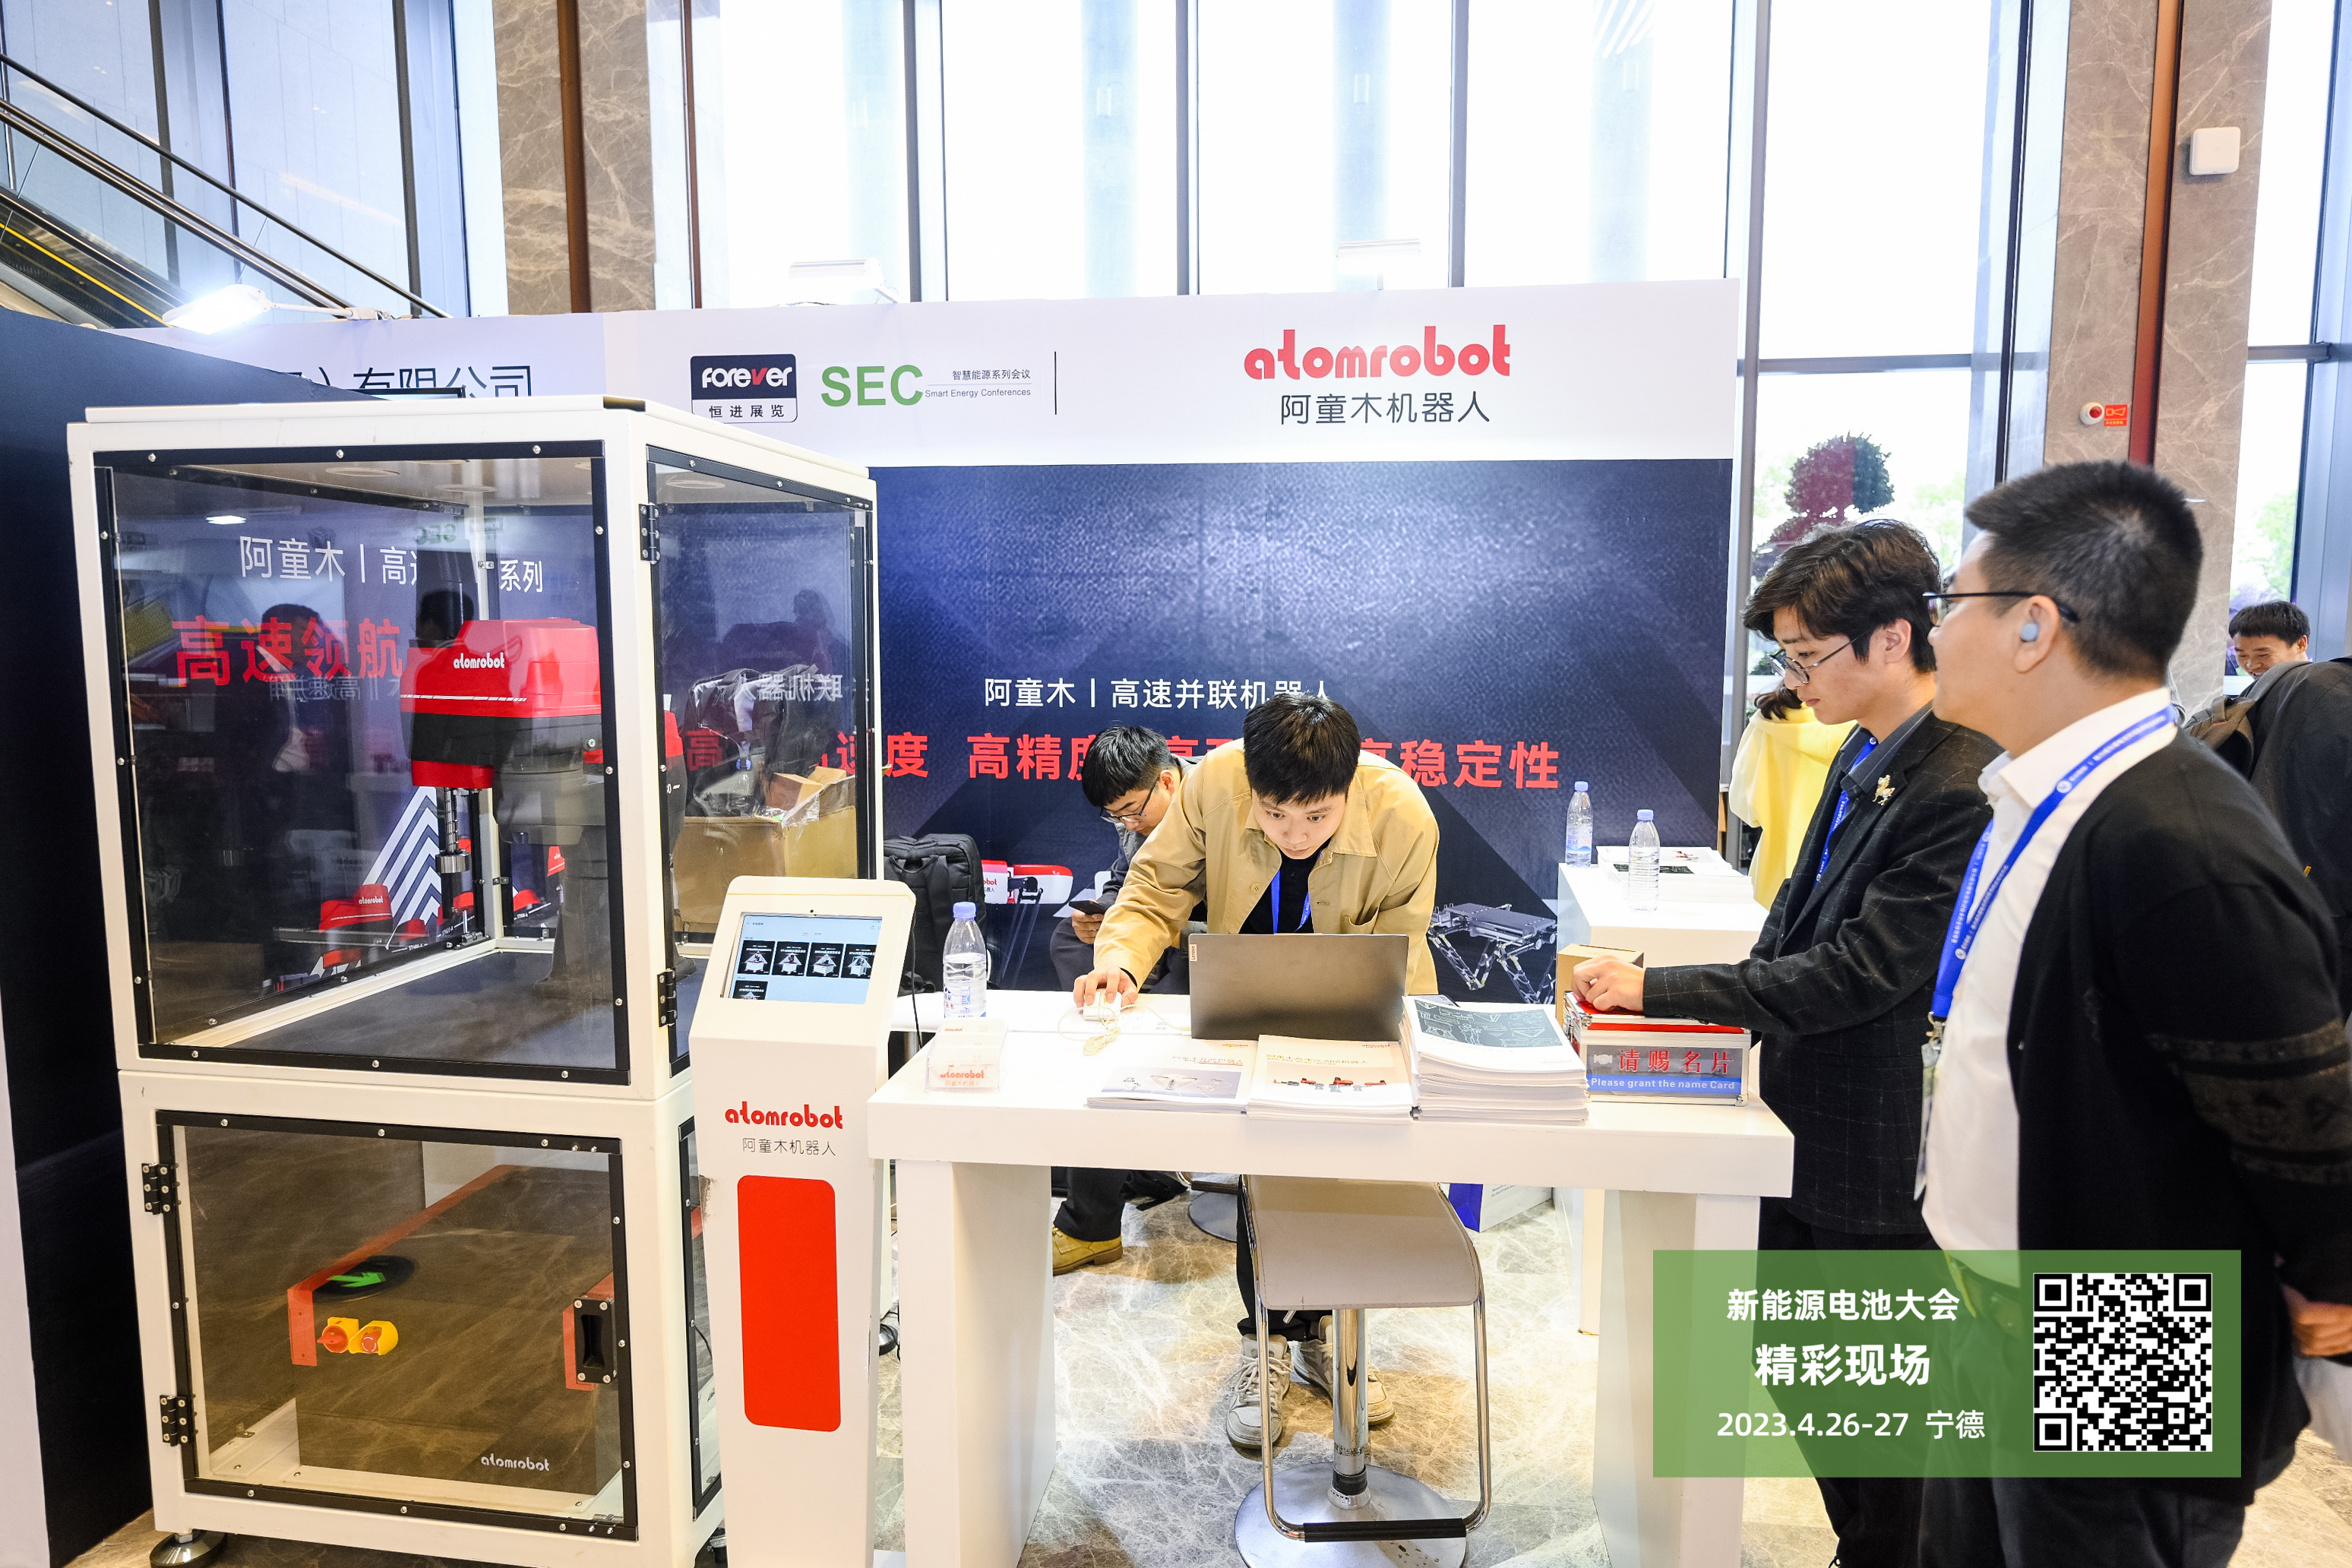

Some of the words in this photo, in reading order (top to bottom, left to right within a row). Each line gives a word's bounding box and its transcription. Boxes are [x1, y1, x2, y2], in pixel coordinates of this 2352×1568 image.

[1244, 324, 1510, 380] atomrobot
[702, 366, 792, 388] forever
[952, 368, 1031, 381] 智慧能源系列会议
[820, 364, 924, 408] SEC
[925, 390, 949, 398] Smart
[950, 389, 978, 399] Energy
[981, 388, 1031, 397] Conferences
[709, 404, 784, 419] 恒进展览
[1281, 390, 1490, 425] 阿童木机器人
[239, 536, 346, 582] 阿童木
[500, 559, 543, 593] 系列
[172, 615, 403, 688] 高速领航
[453, 651, 505, 669] atomrobot
[985, 678, 1076, 708] 阿童木
[359, 895, 384, 905] atomrobot
[1617, 1048, 1734, 1075] 请赐名片
[940, 1070, 985, 1079] atomrobot
[1591, 1077, 1625, 1087] Please
[1627, 1079, 1656, 1089] grant
[1658, 1080, 1675, 1088] the
[1709, 1080, 1735, 1089] Card
[725, 1101, 843, 1130] atomrobot
[742, 1137, 836, 1156] 阿童木机器人
[481, 1453, 550, 1472] atomrobot
